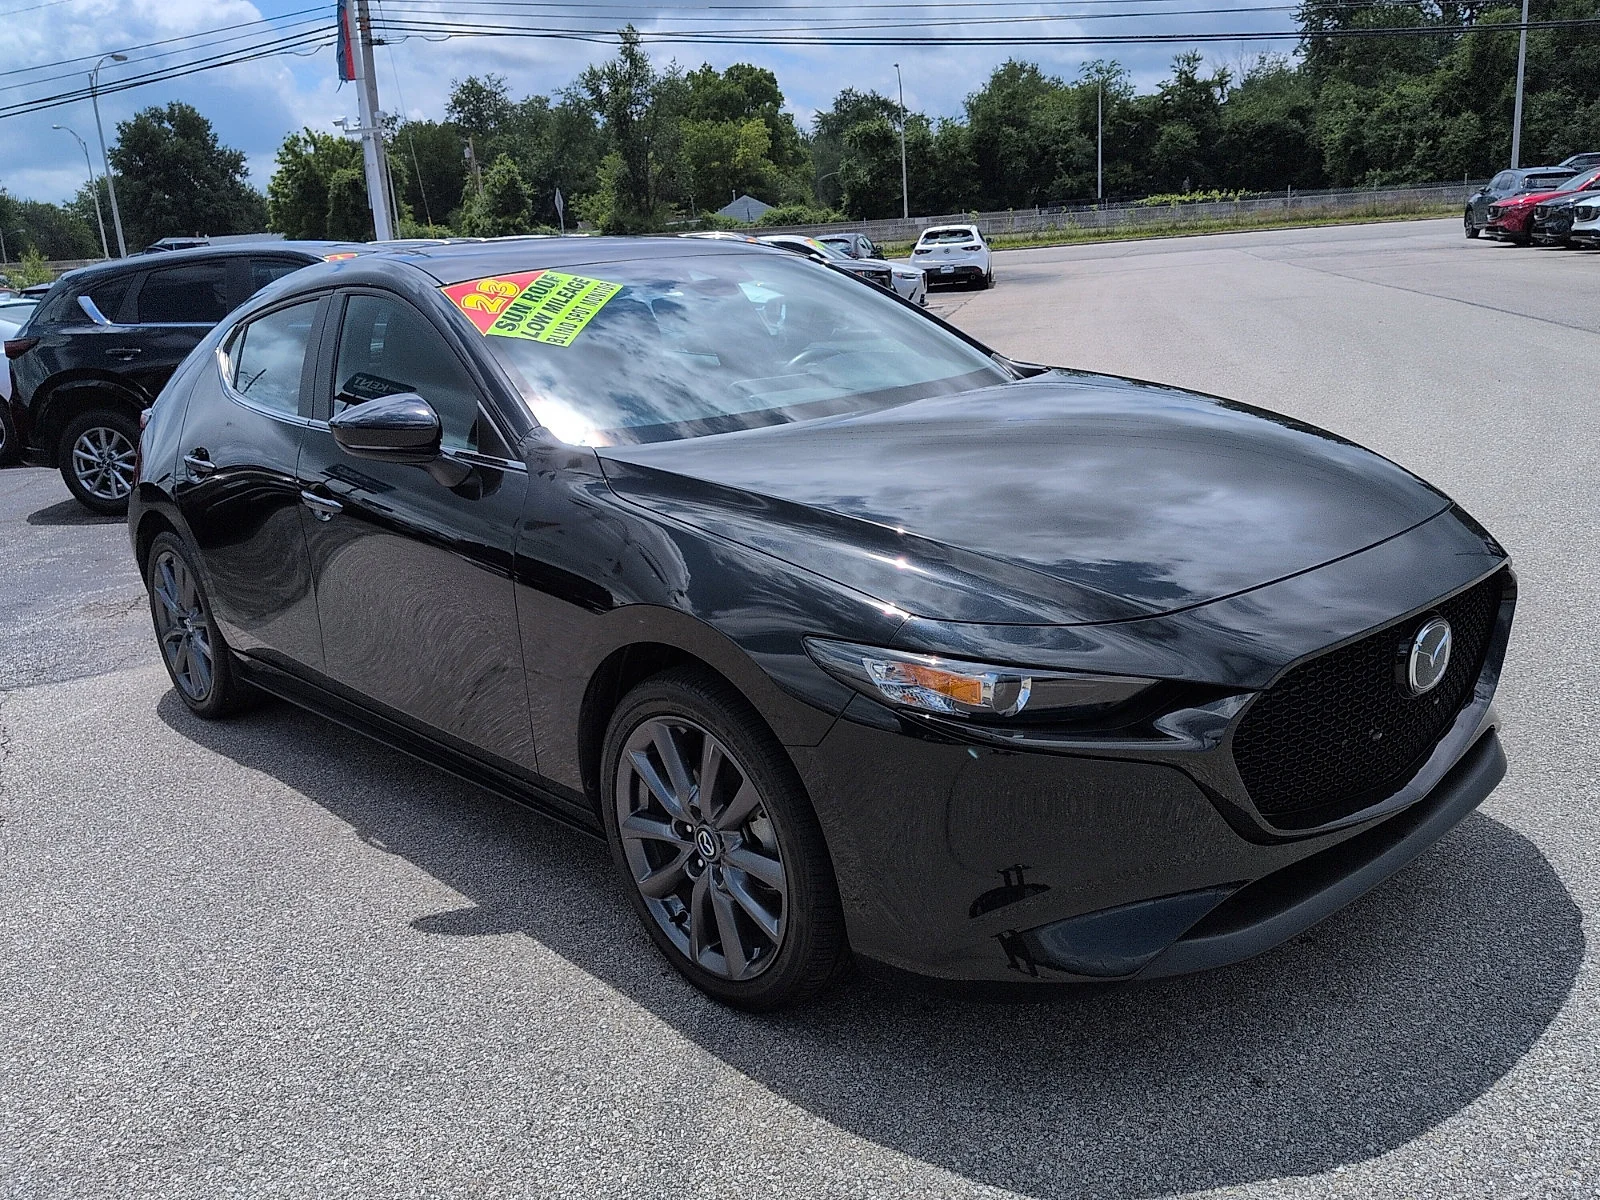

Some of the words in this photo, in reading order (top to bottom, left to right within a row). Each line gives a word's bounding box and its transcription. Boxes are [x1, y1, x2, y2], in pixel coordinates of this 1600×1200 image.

[461, 279, 520, 315] 23
[495, 303, 532, 332] SUN
[521, 274, 561, 304] ROOF
[521, 313, 554, 338] LOW
[542, 277, 591, 314] MILEAGE
[546, 319, 578, 344] BLIND
[565, 306, 593, 323] SPOT
